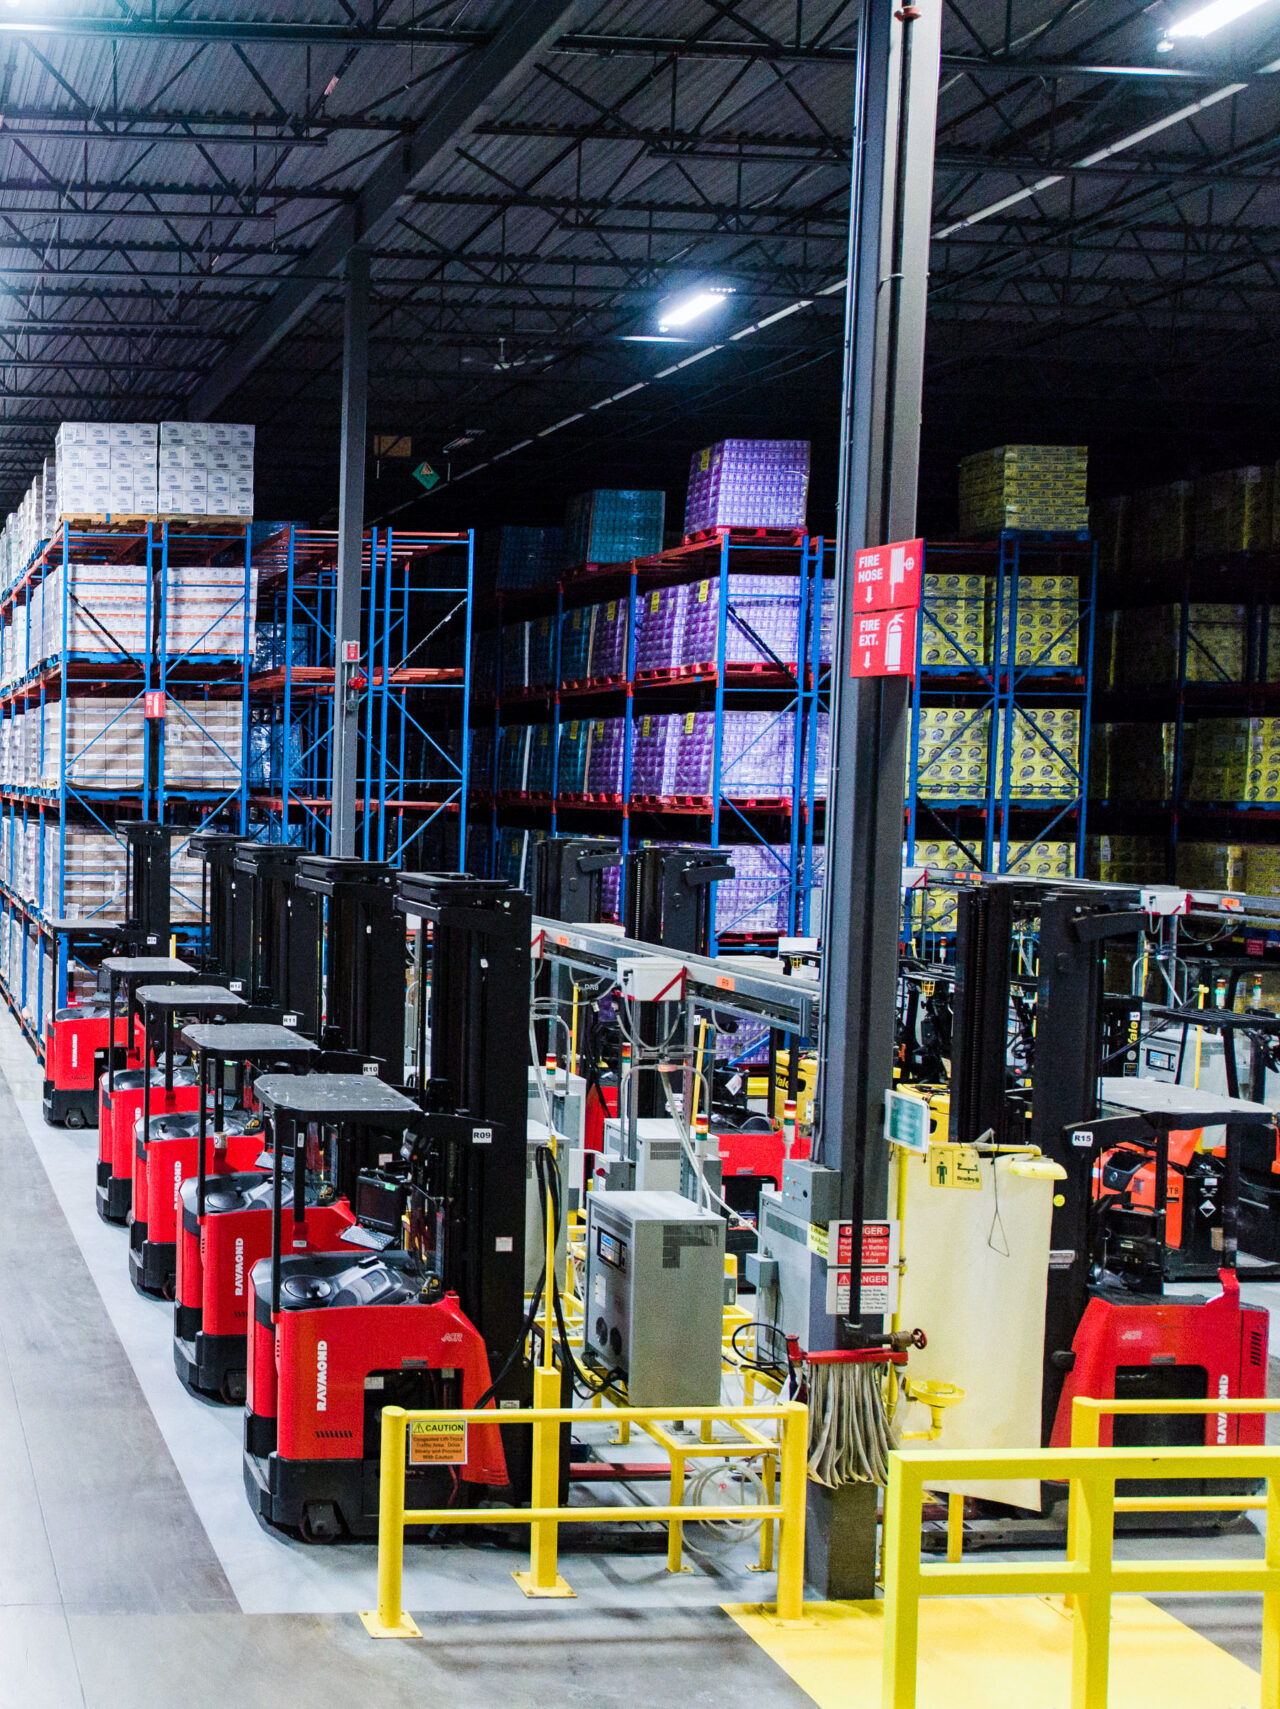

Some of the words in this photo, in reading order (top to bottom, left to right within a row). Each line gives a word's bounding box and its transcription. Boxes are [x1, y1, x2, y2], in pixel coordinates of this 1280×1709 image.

[858, 554, 880, 568] FIRE
[858, 568, 883, 583] HOSE
[860, 619, 880, 632] FIRE
[859, 633, 879, 647] EXT.
[845, 1227, 883, 1235] DGER
[235, 1238, 243, 1296] RAYMOND
[861, 1275, 888, 1284] NGER
[316, 1340, 328, 1412] RAYMOND
[425, 1424, 464, 1432] CAUTION
